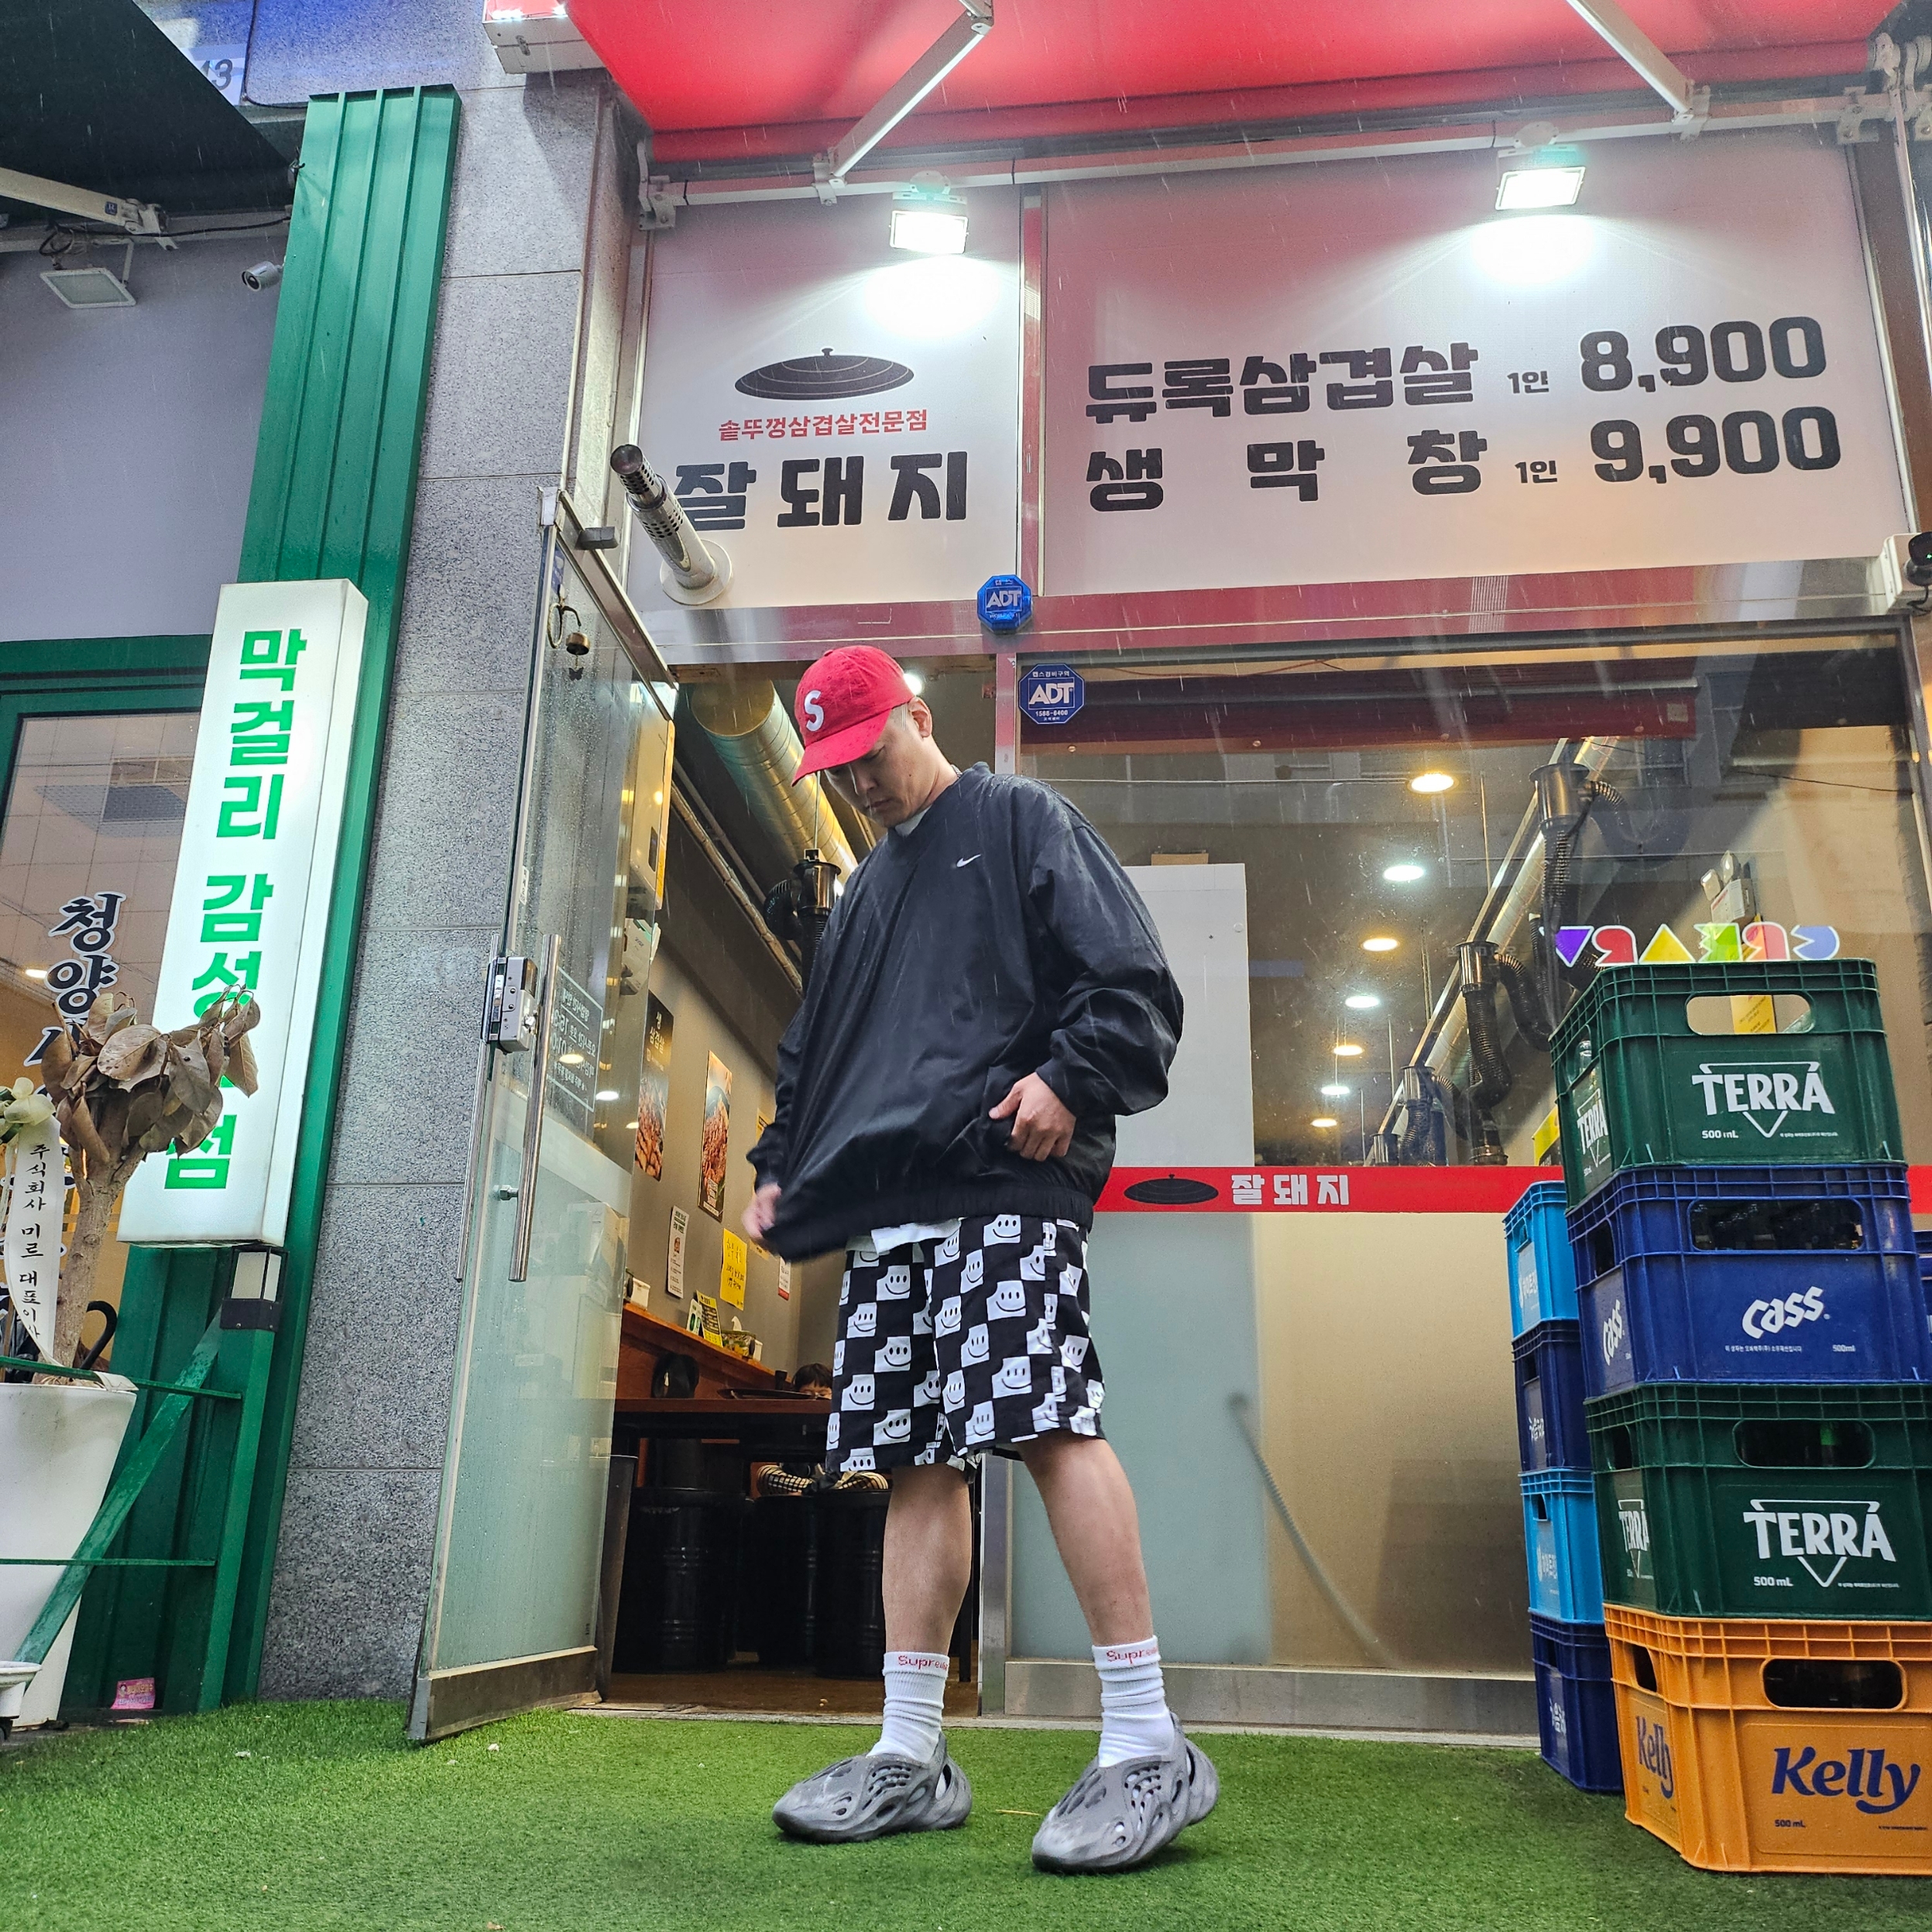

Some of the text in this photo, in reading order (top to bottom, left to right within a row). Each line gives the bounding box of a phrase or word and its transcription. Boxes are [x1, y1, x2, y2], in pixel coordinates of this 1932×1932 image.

[1085, 315, 1827, 424] 듀록삼겹살 1인 8,900
[719, 409, 928, 441] 솥뚜껑삼겹살전문점
[1515, 462, 1558, 484] 1인
[1589, 405, 1840, 483] 9,900
[987, 590, 1021, 607] ADT
[805, 690, 824, 732] S
[1029, 682, 1074, 704] ADT
[216, 628, 307, 840] 막걸리
[163, 873, 274, 1190] 감성점
[1692, 1072, 1835, 1116] TERRA
[1577, 1098, 1609, 1155] TERRA
[1702, 1130, 1721, 1138] 500
[1618, 1511, 1650, 1553] TERRA
[1743, 1512, 1896, 1562] TERRA
[1753, 1577, 1775, 1586] 500
[1636, 1715, 1674, 1799] Kelly
[1772, 1746, 1921, 1814] Kelly
